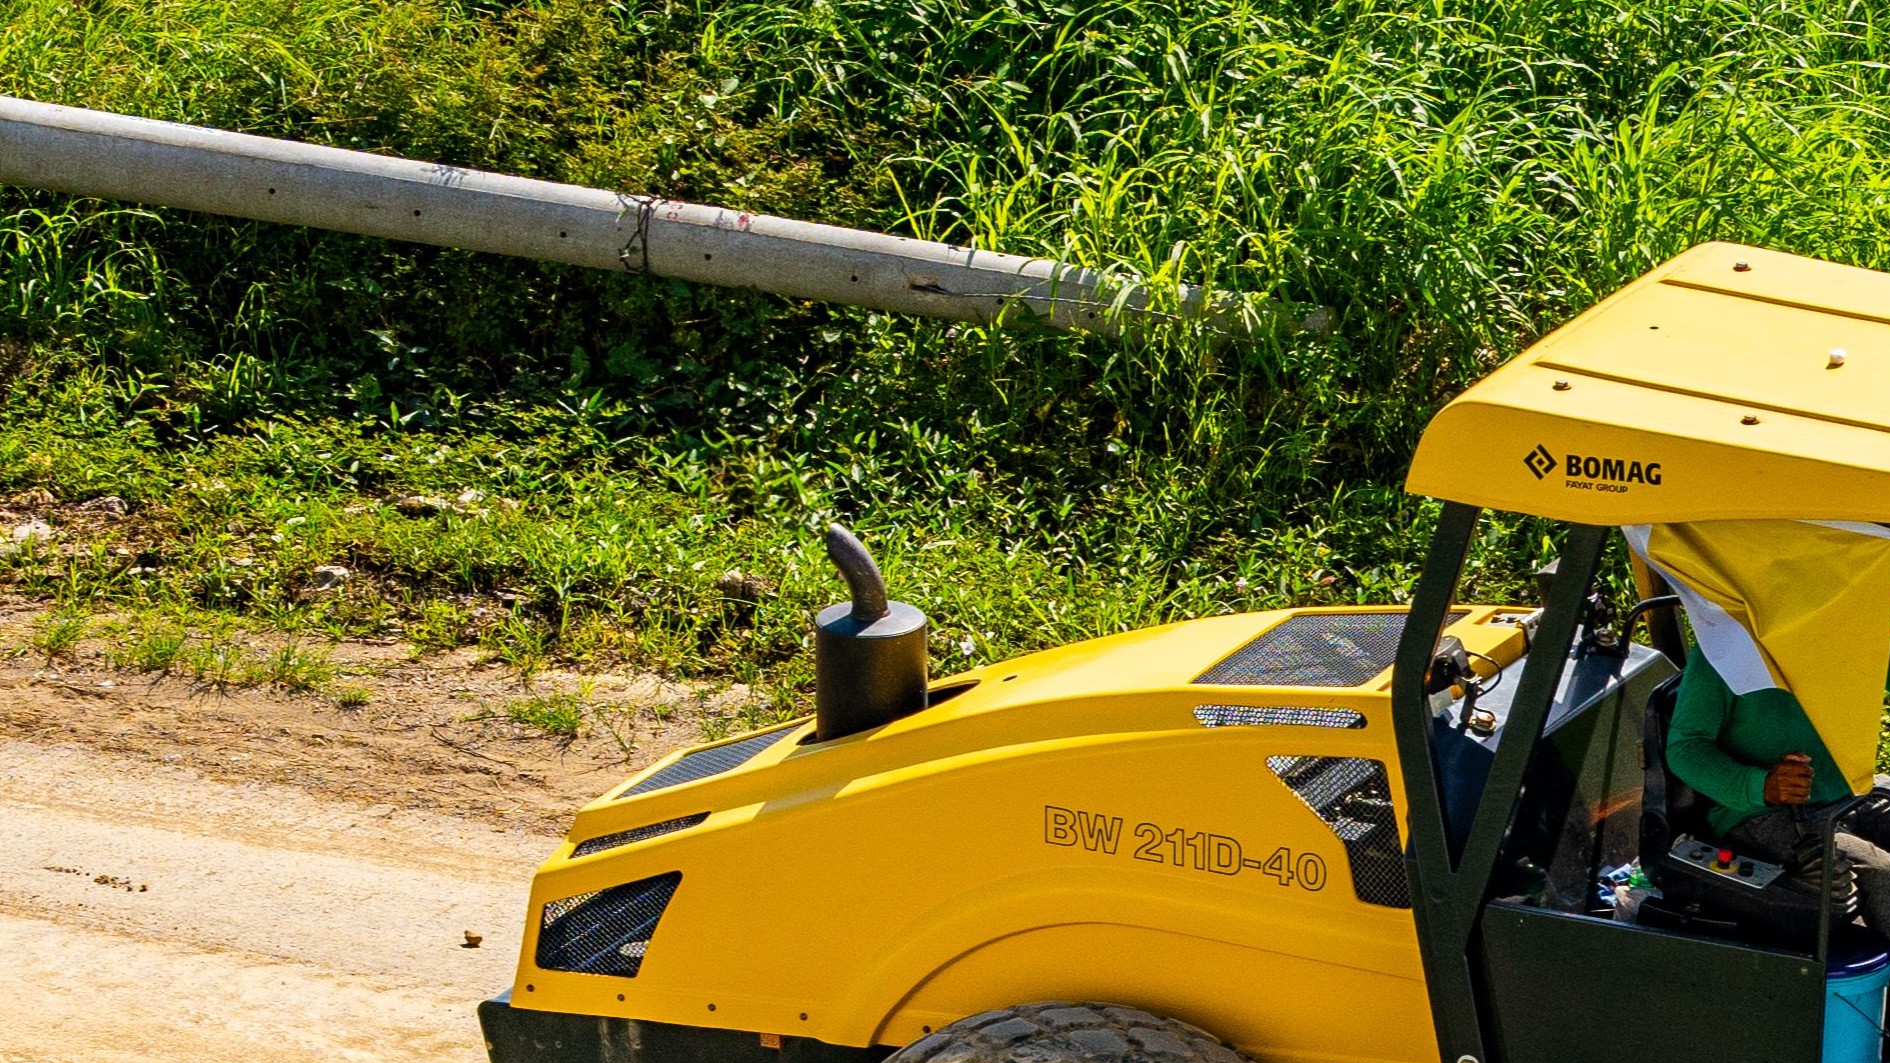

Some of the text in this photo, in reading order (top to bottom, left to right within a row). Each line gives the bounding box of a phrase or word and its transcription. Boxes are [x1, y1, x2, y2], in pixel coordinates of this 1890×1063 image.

[1565, 454, 1662, 486] BOMAG
[1565, 480, 1628, 493] FAYAT GROUP
[1045, 805, 1327, 892] BW 211D-40
